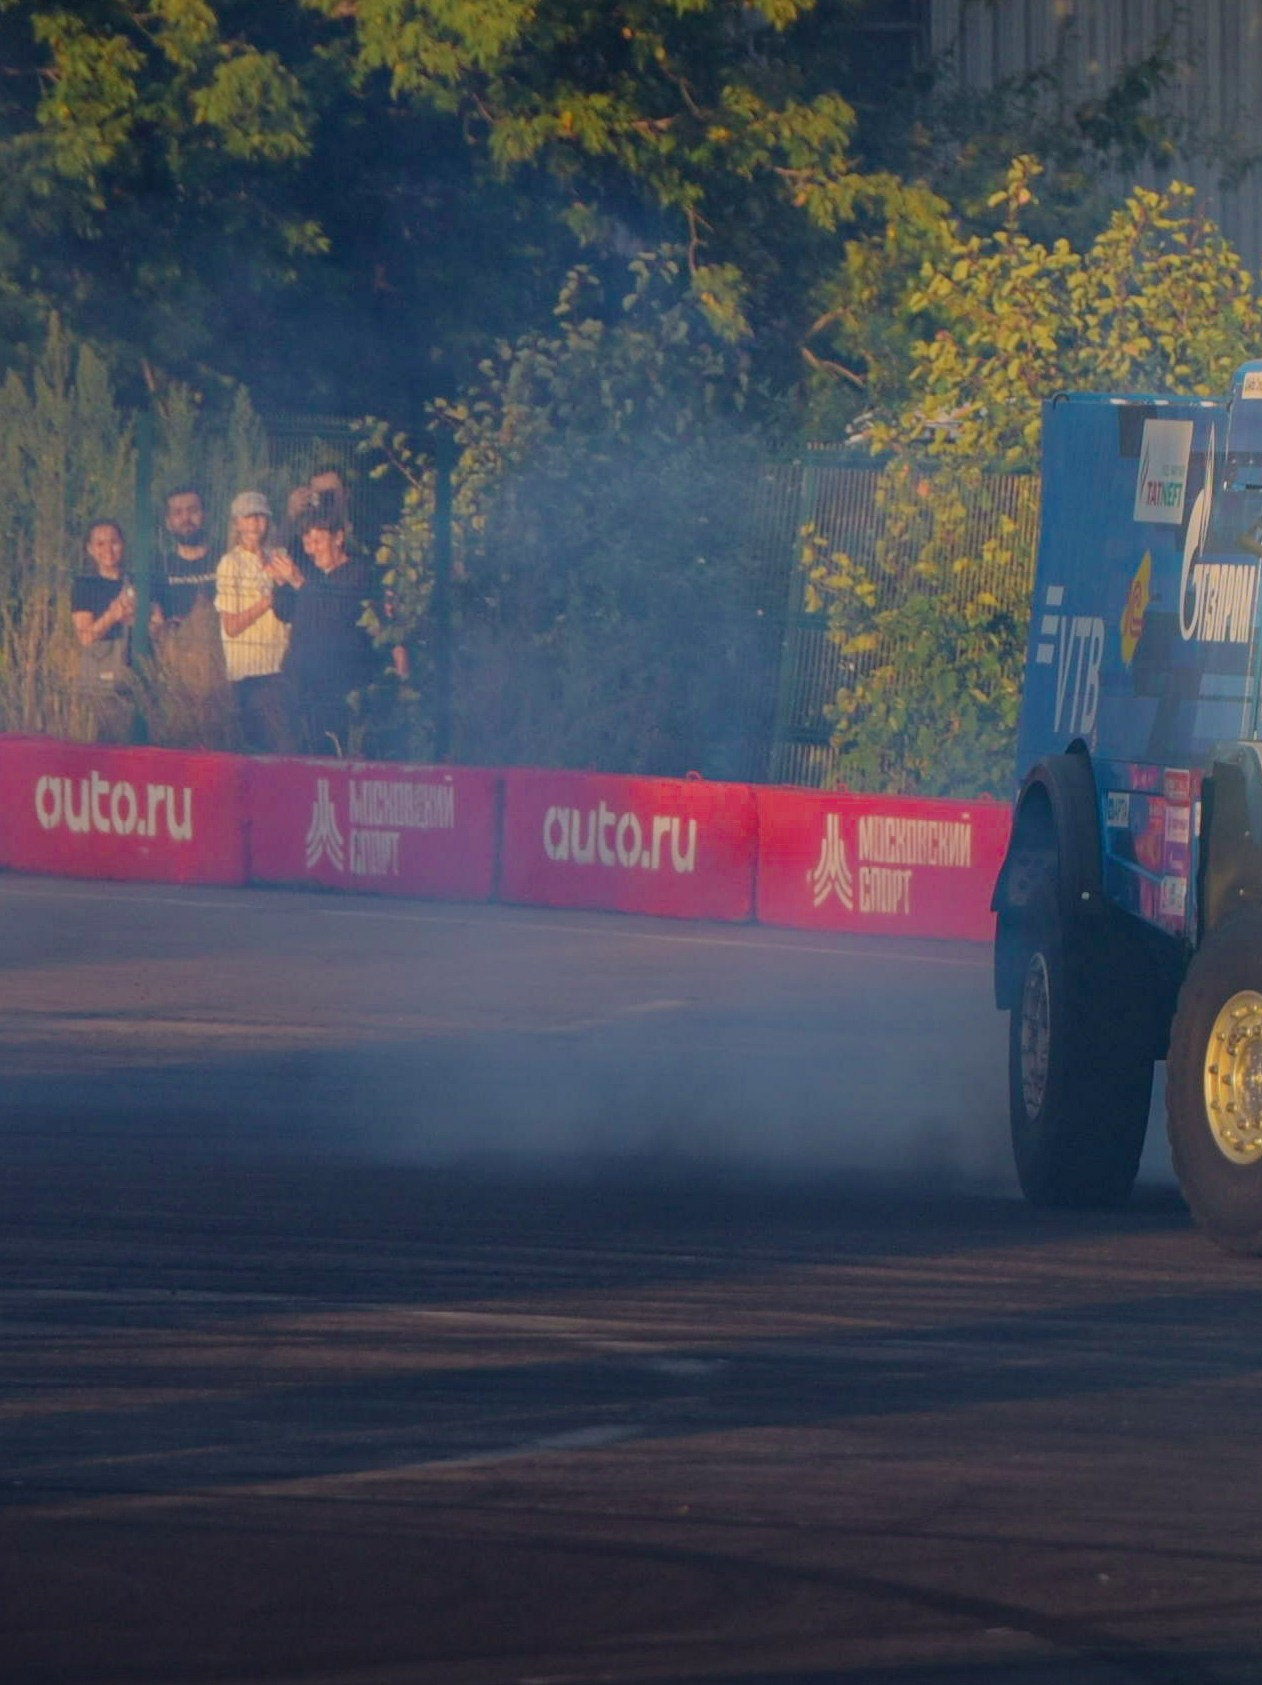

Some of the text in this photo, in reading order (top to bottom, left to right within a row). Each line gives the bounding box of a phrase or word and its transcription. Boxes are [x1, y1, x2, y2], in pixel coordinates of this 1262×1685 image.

[1147, 481, 1182, 507] TATNEFT
[1055, 616, 1105, 734] VTB
[36, 770, 193, 841] auto.ru
[543, 801, 697, 872] auto.ru
[858, 813, 972, 868] МОСКОВСКИЙ
[858, 868, 912, 914] СПОРТ
